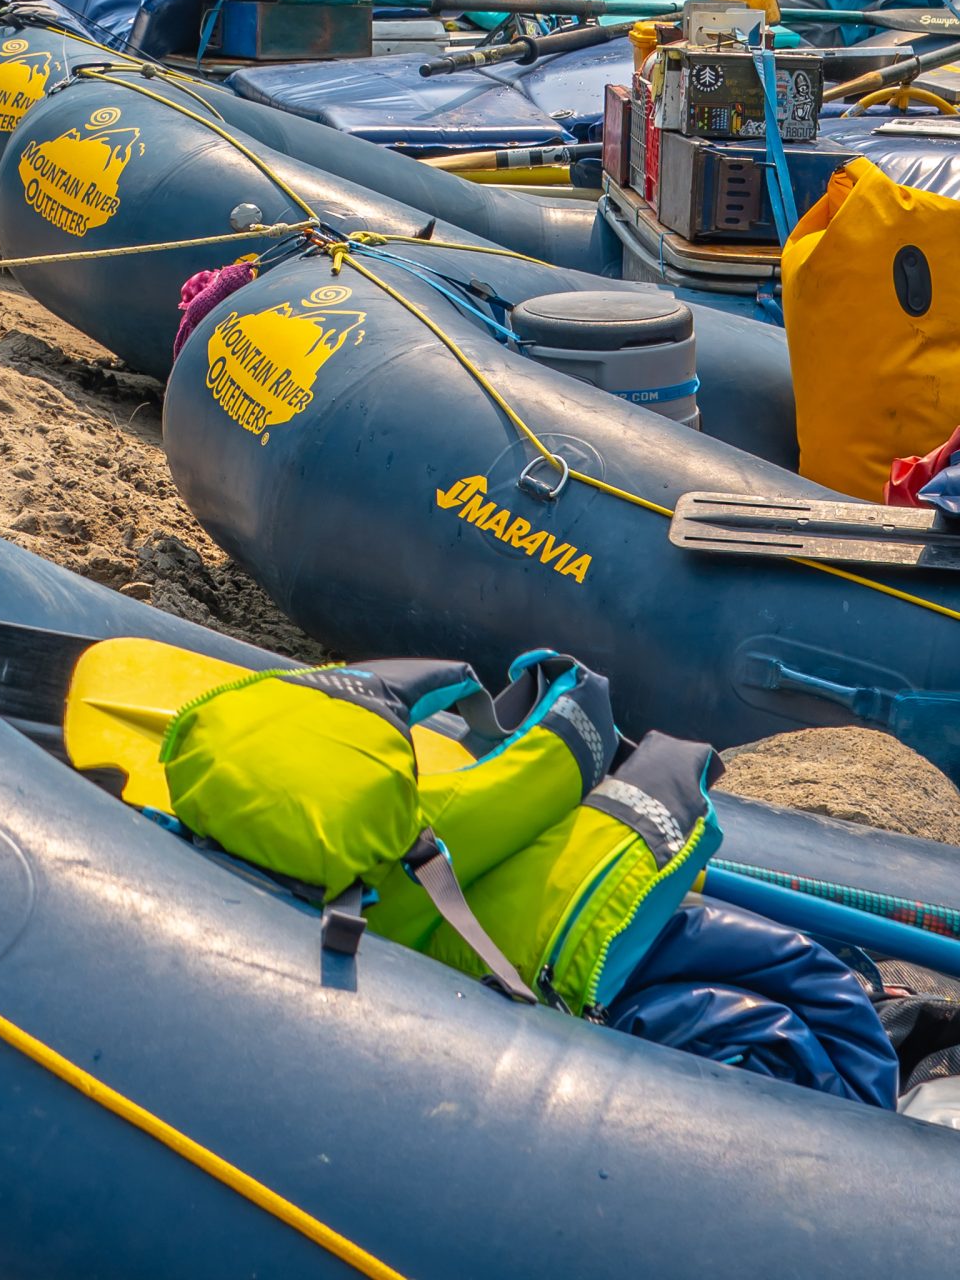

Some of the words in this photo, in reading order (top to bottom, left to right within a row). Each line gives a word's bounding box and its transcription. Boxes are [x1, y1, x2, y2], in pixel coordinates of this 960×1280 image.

[920, 15, 959, 28] Sawyer
[10, 91, 36, 110] RIV
[22, 142, 85, 200] MOUNTAIN
[81, 181, 119, 214] RIVER
[26, 178, 90, 235] OUTFITTERS
[208, 355, 272, 431] OUTFITTERS
[217, 313, 279, 387] MOUNTAIN
[267, 367, 312, 411] RIVER
[457, 493, 593, 584] MARAVIA
